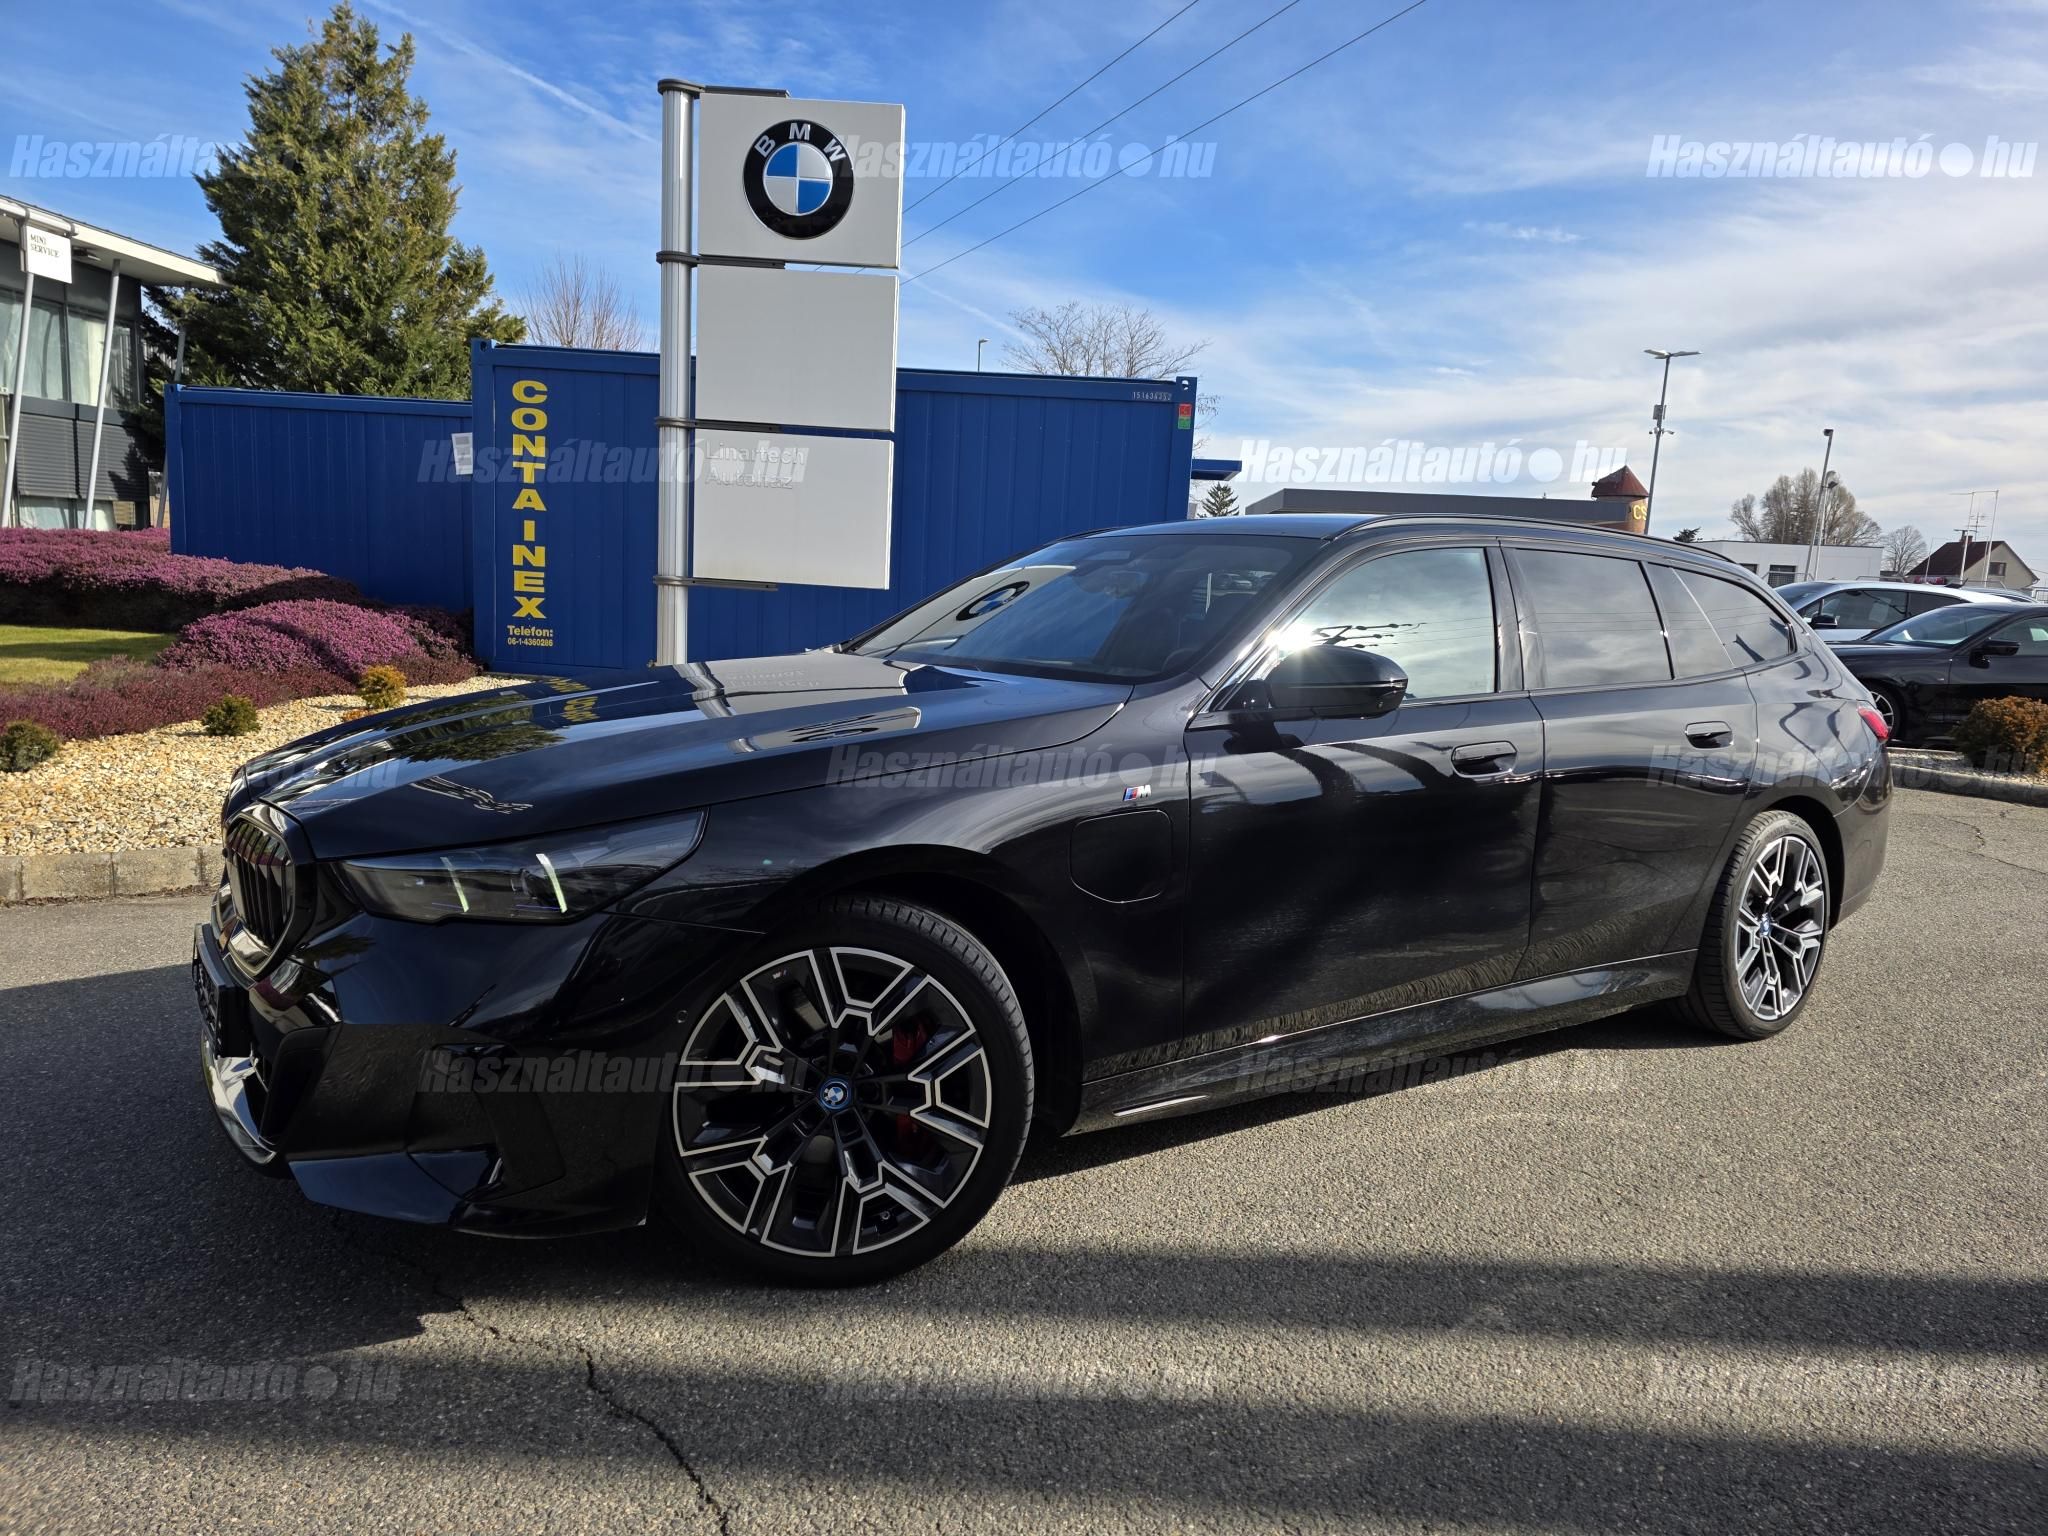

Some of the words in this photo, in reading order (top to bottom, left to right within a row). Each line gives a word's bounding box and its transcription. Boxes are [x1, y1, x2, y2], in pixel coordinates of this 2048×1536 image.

[754, 122, 847, 163] BMW
[31, 243, 60, 258] SERVICE
[705, 440, 805, 465] Linartech
[511, 380, 548, 619] CONTAINEX
[507, 624, 553, 637] Telefon:
